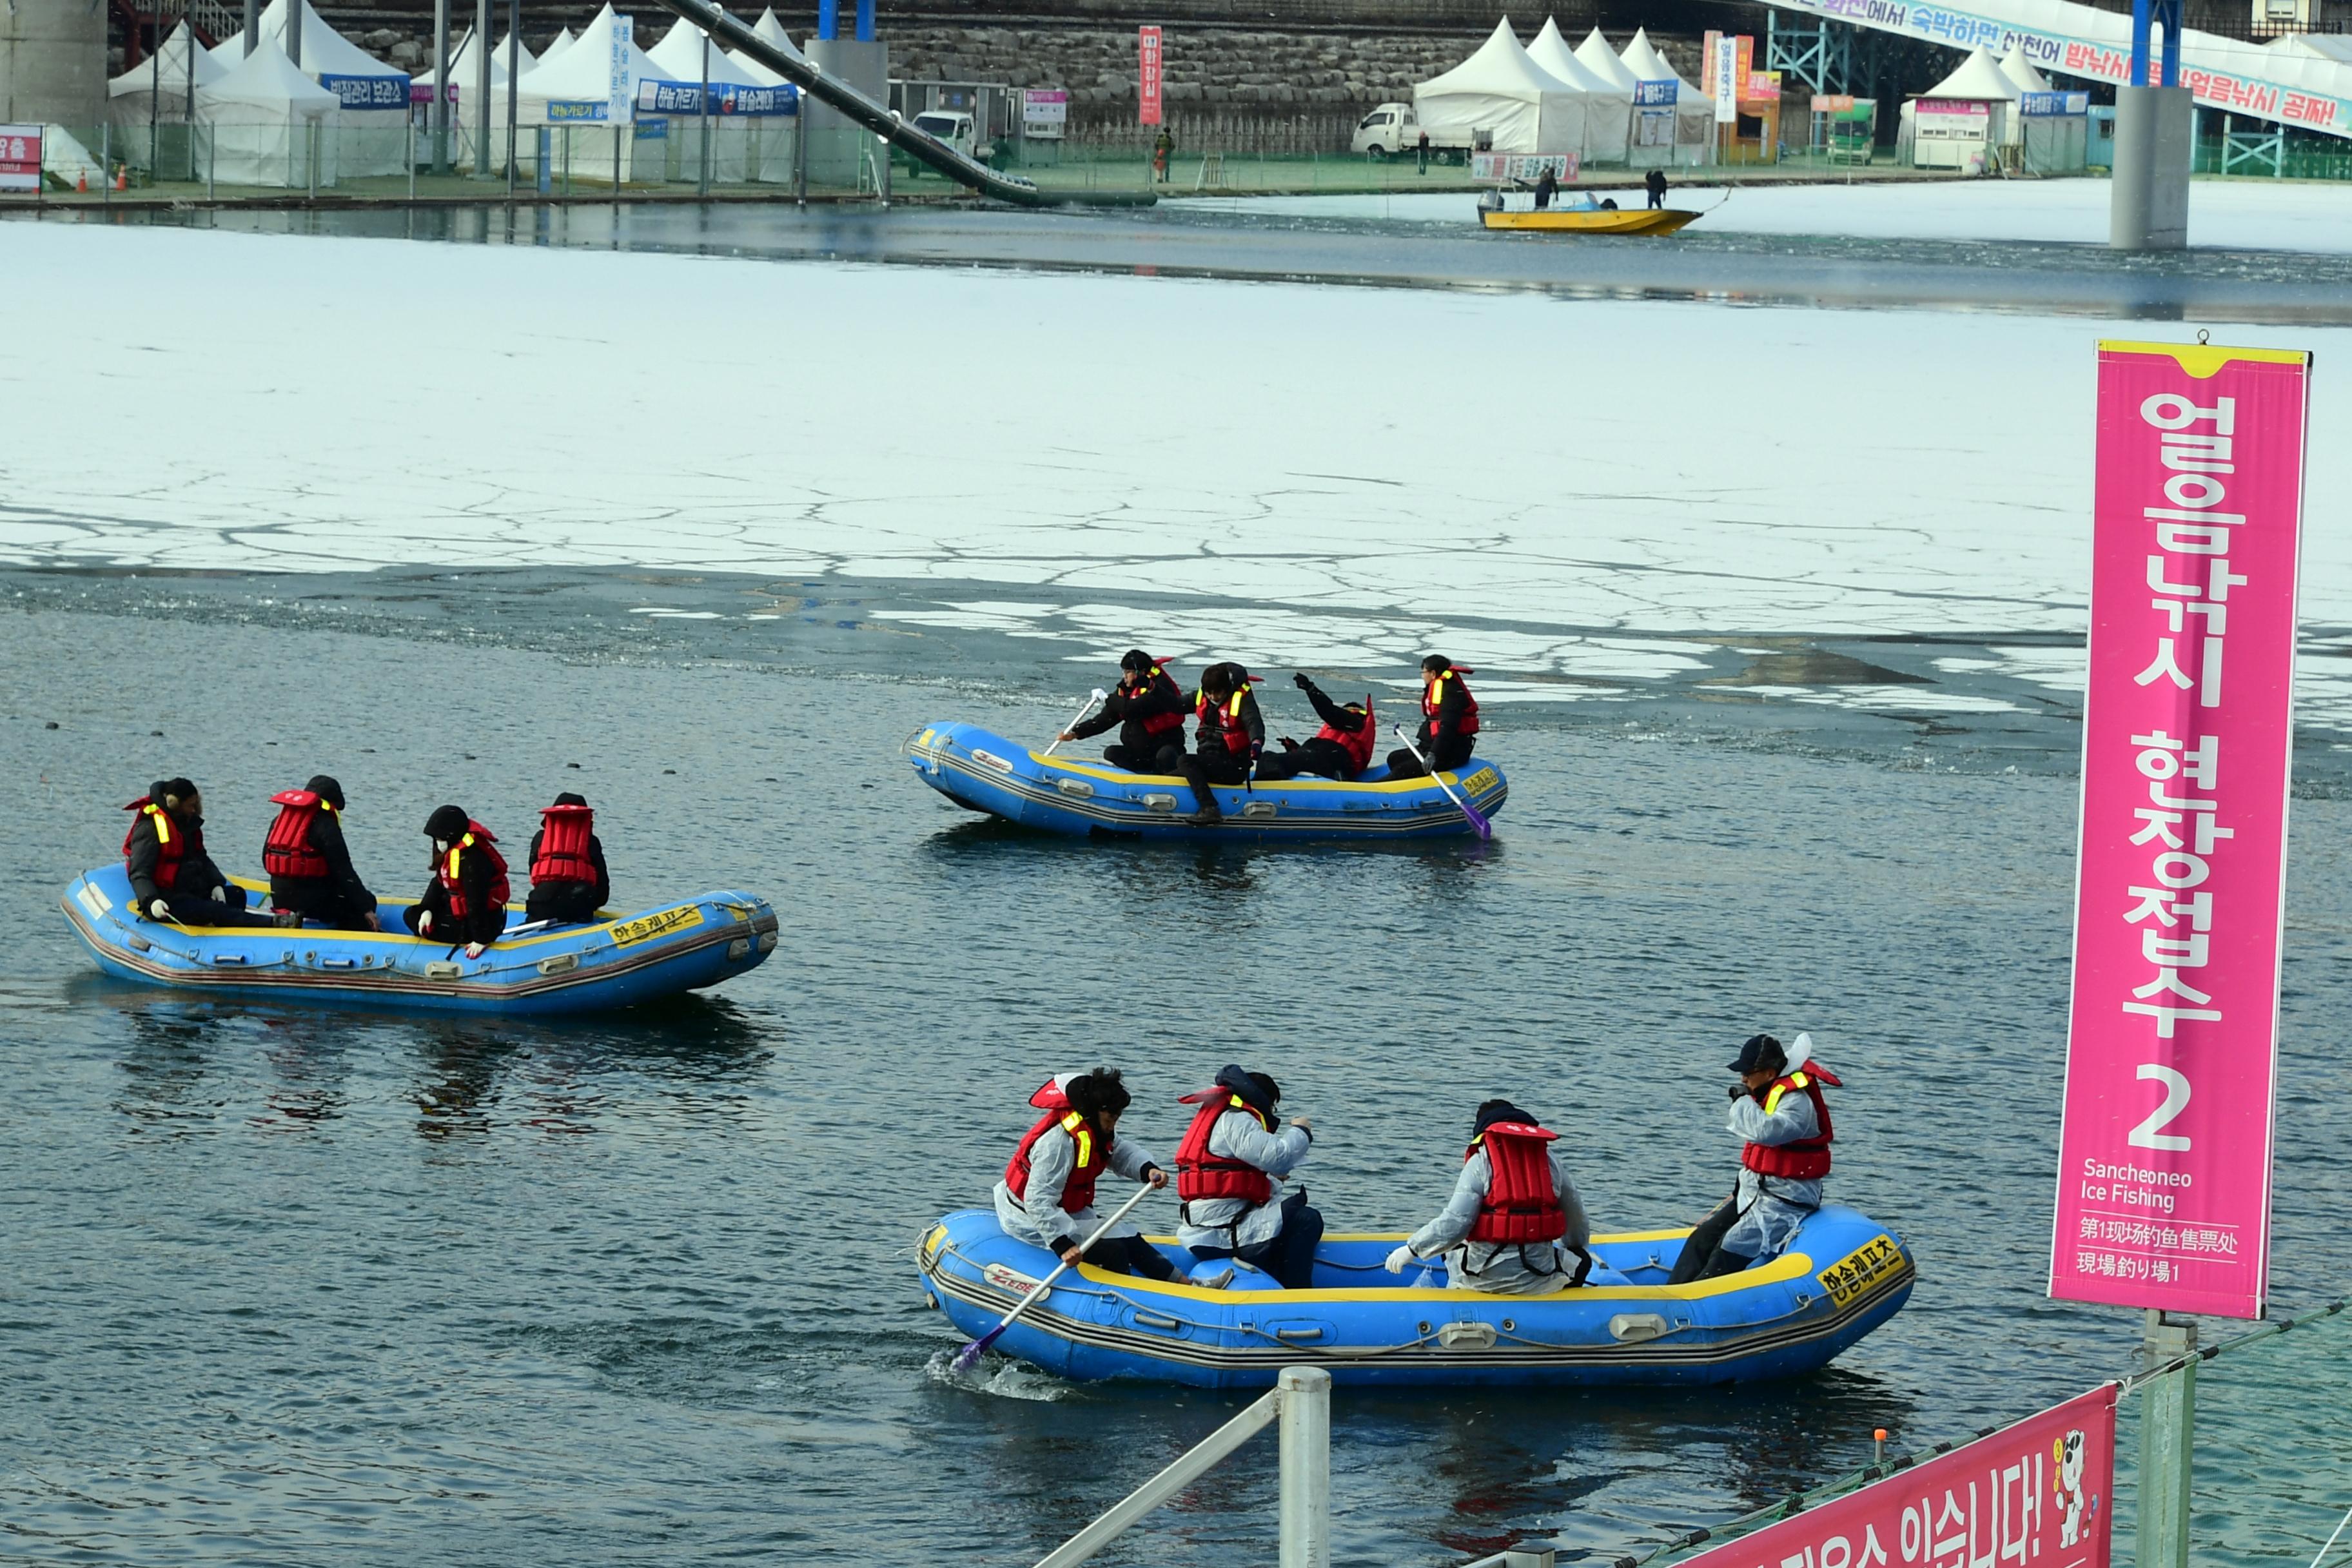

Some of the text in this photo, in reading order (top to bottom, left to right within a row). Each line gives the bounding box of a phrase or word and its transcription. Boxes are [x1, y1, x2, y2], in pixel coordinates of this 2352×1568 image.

[1145, 49, 1157, 97] 화장실
[1721, 44, 1731, 101] 얼음축구
[1912, 7, 1999, 49] 숙박하면
[2003, 30, 2061, 63] 산천어
[2065, 43, 2133, 80] 밤낚시
[2282, 92, 2336, 126] 공짜!
[373, 81, 401, 103] 보관소
[657, 86, 700, 110] 하늘가르기
[551, 104, 593, 117] 하늘가르기
[2122, 393, 2248, 1152] 얼음낚시 현장접수 2
[2083, 1158, 2192, 1188] Sancheoneo
[2081, 1181, 2175, 1213] Ice Fishing
[2079, 1217, 2238, 1255] 第1现场钓鱼售票处
[2076, 1252, 2179, 1282] 現場釣り場1
